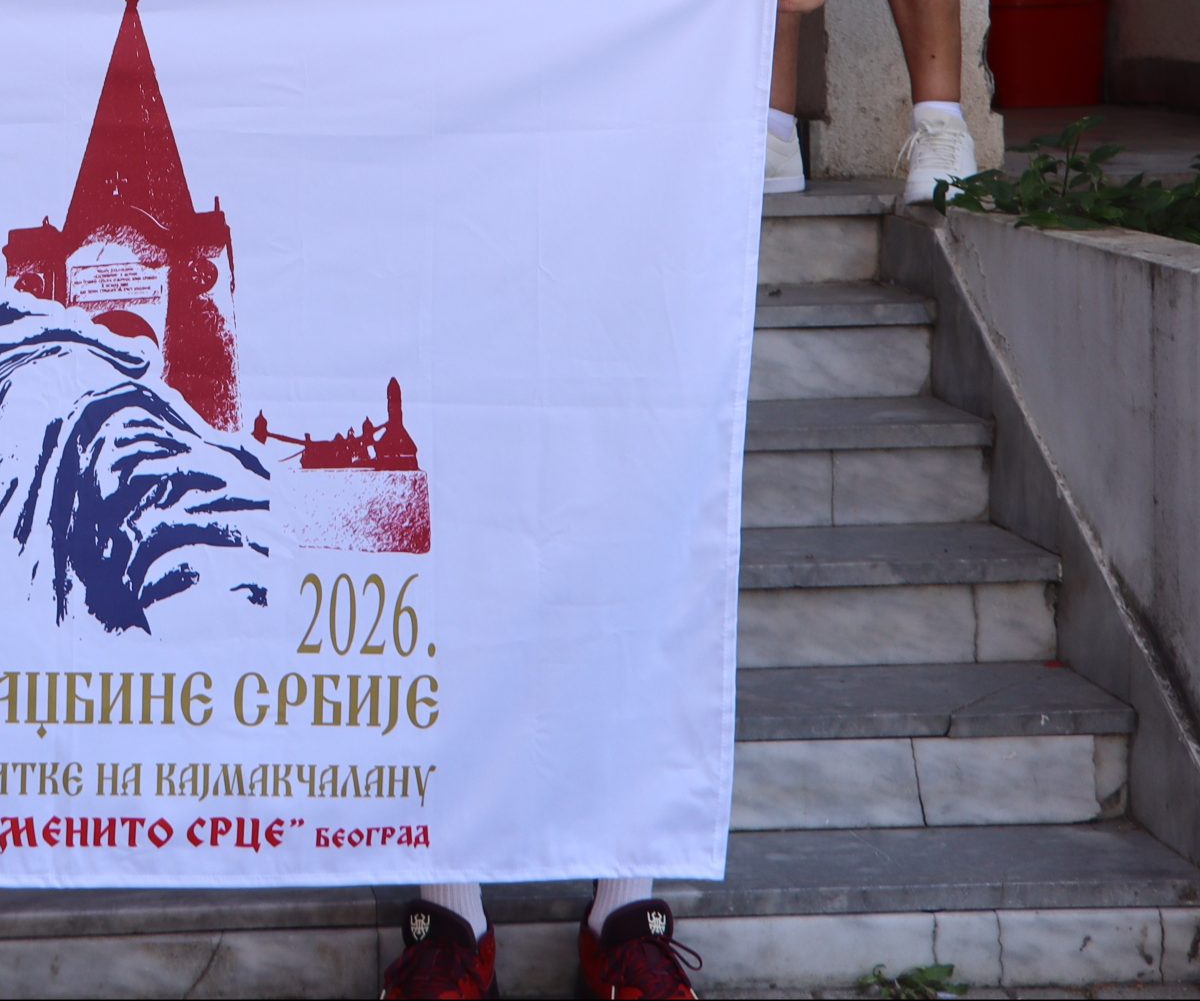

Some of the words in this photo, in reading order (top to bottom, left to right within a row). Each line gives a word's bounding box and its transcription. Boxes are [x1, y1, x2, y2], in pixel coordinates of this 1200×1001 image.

[297, 573, 438, 659] 2026.
[233, 673, 441, 737] СРБИЈЕ
[96, 762, 143, 798] НА
[154, 762, 437, 808] КАЈМАКЧАЛАНУ
